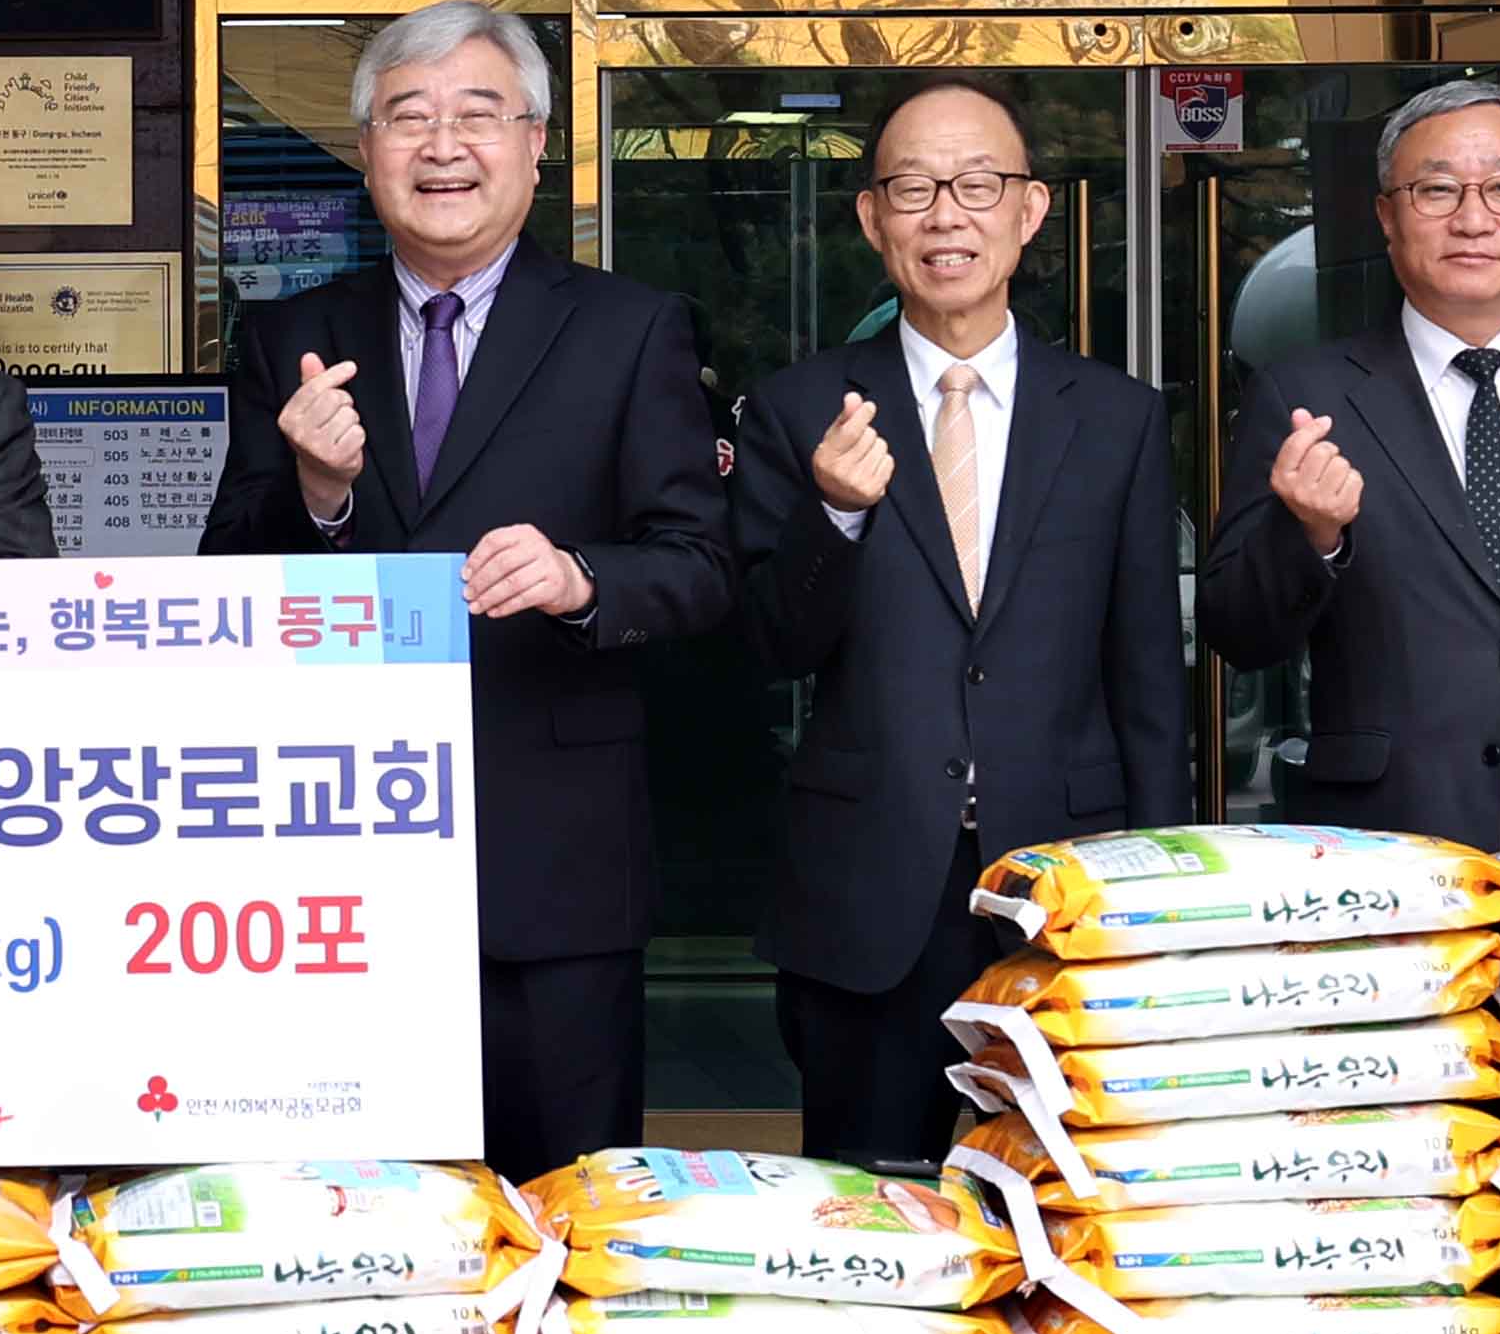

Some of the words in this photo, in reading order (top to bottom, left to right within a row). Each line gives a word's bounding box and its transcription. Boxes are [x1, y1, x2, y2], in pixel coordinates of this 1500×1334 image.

[64, 72, 88, 81] Child
[1170, 73, 1201, 84] CCTV
[64, 83, 100, 94] Friendly
[64, 94, 89, 102] Cities
[64, 103, 105, 112] Initiative
[1181, 107, 1224, 123] BOSS
[27, 191, 56, 201] unicef
[5, 292, 34, 303] Health
[15, 342, 25, 354] is
[28, 343, 40, 354] to
[42, 342, 82, 356] certify
[84, 342, 108, 354] that
[68, 400, 205, 417] INFORMATION
[103, 430, 129, 441] 503
[103, 451, 129, 462] 505
[139, 448, 212, 460] 노조사무실
[103, 474, 130, 485] 403
[139, 471, 212, 484] 재난상황실
[103, 496, 130, 507] 405
[140, 493, 213, 505] 안전관리과
[104, 517, 131, 528] 408
[50, 596, 254, 651] 행복도시
[127, 896, 368, 974] 200포
[186, 1099, 217, 1116] 인천
